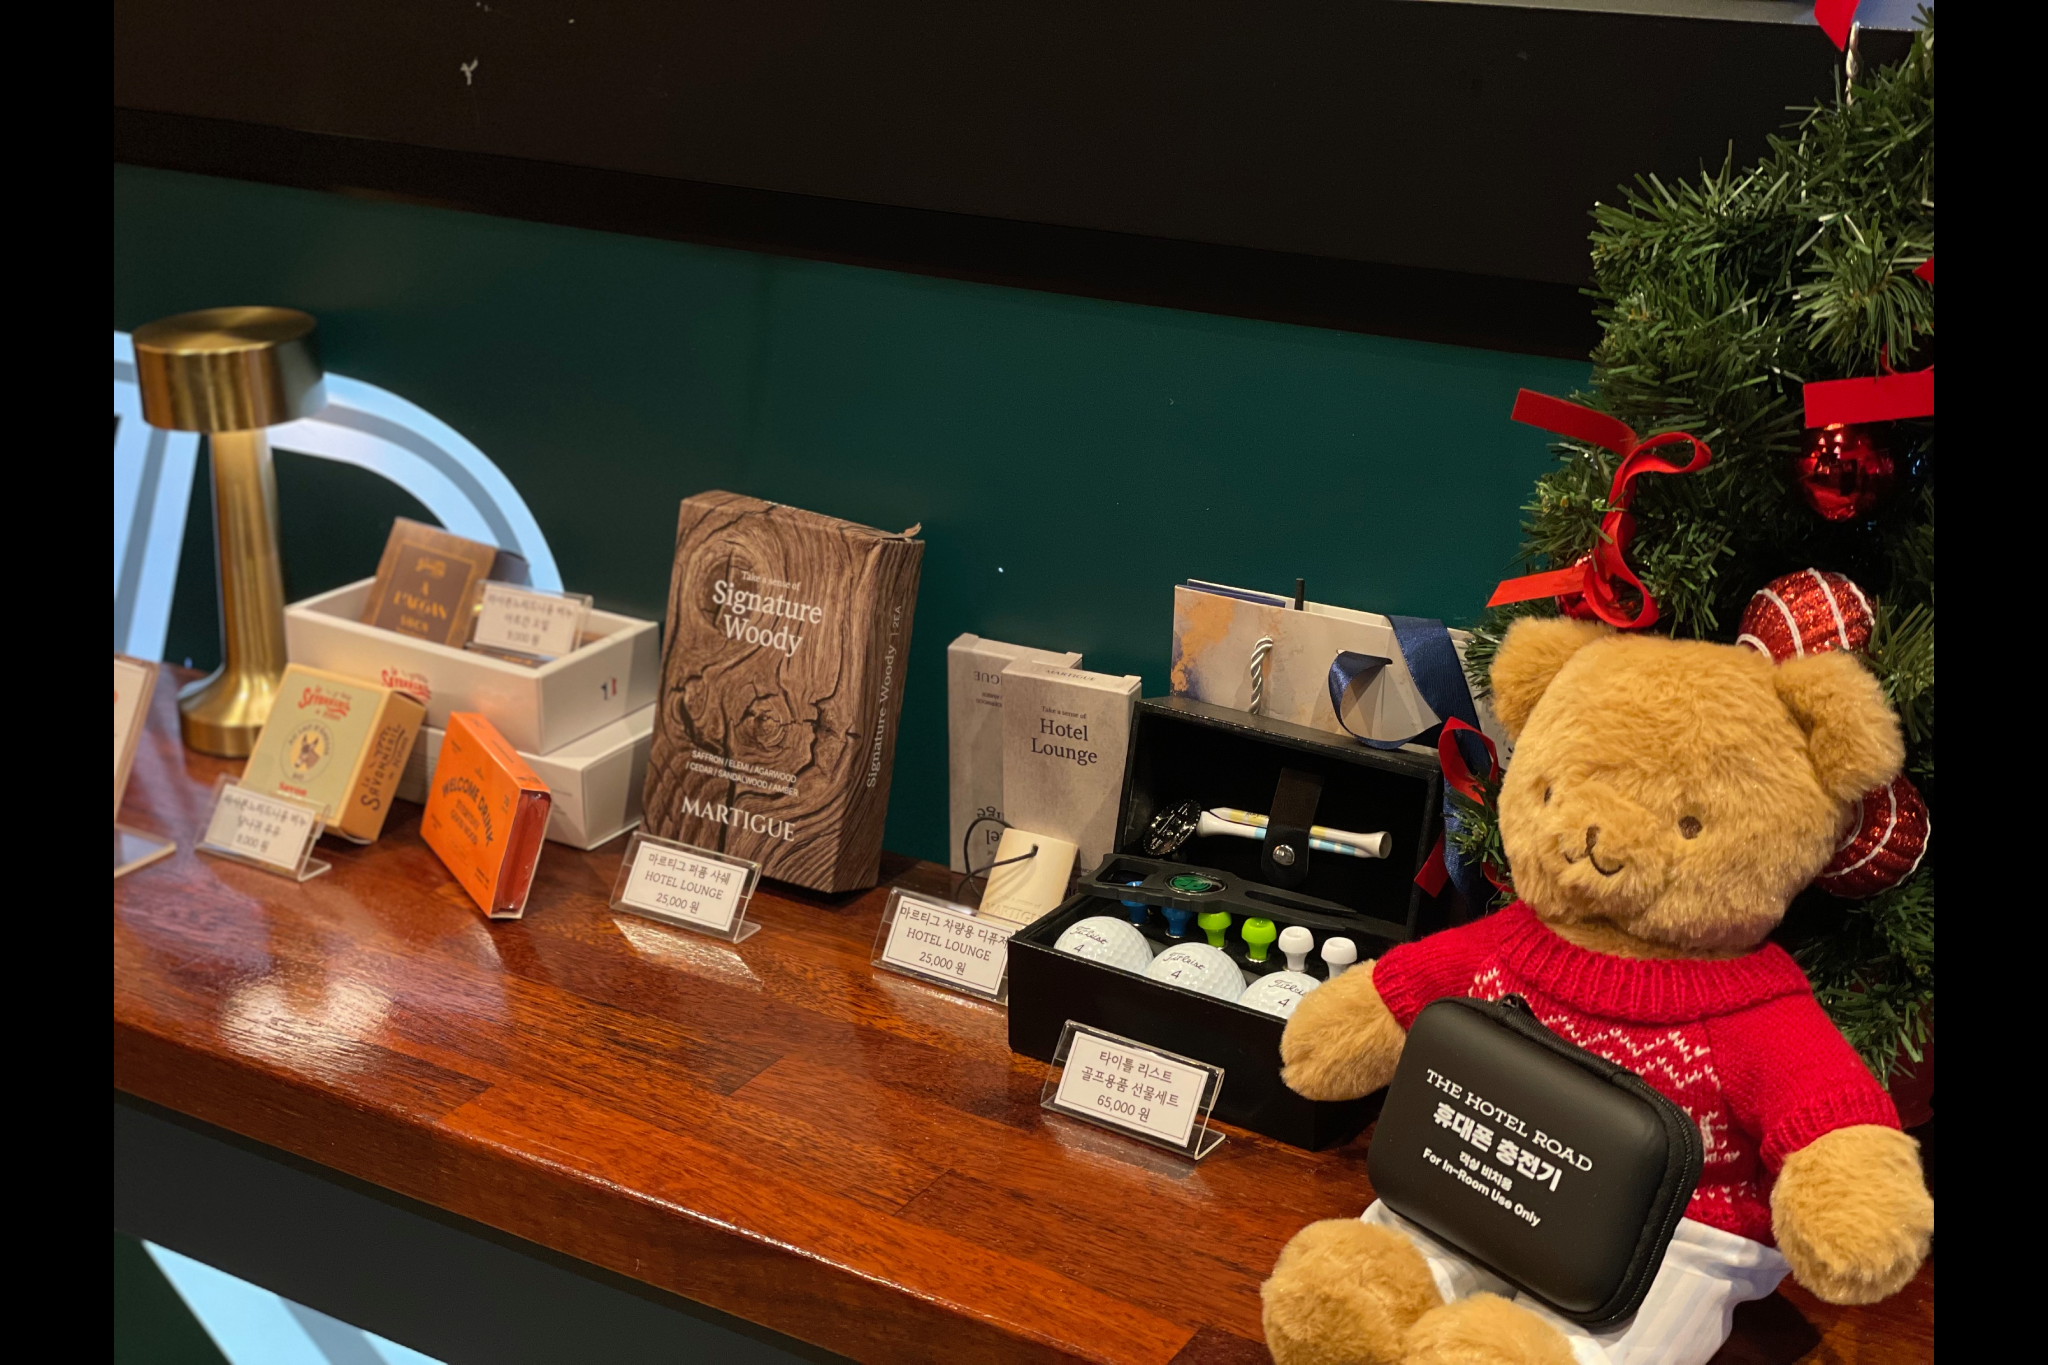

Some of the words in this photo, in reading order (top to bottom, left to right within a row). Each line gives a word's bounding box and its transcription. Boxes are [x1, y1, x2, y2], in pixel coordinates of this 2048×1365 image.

[741, 570, 760, 584] Take
[768, 579, 790, 589] sense
[791, 581, 801, 591] of
[712, 579, 822, 624] Signature
[724, 614, 803, 657] Woody
[867, 708, 886, 787] Signature
[880, 645, 897, 703] Woody
[892, 606, 902, 628] 2EA
[1041, 705, 1057, 714] Take
[1062, 710, 1080, 719] sense
[1039, 717, 1089, 741] Hotel
[692, 750, 724, 765] SAFFRON
[729, 760, 749, 773] ELEMI
[754, 766, 797, 783] AGARWOOD
[1031, 737, 1098, 767] Lounge
[690, 762, 713, 776] CEDAR
[718, 769, 768, 789] SANDALWOOD
[773, 785, 799, 797] AMBER
[442, 777, 480, 801] WELCOME
[477, 796, 494, 847] DRINK
[681, 796, 796, 841] MARTIGUE
[648, 853, 686, 872] 마르티그
[644, 870, 678, 889] HOTEL
[680, 879, 724, 900] LOUNGE
[656, 892, 688, 909] 25,000
[689, 901, 700, 914] 원
[900, 906, 941, 927] 마르티그
[943, 918, 975, 938] 차량용
[906, 927, 942, 947] HOTEL
[945, 938, 992, 961] LOUNGE
[1074, 943, 1085, 953] 4
[919, 951, 953, 970] 25,000
[955, 962, 966, 975] 원
[1170, 969, 1182, 980] 4
[1278, 997, 1290, 1008] 4
[1099, 1050, 1134, 1074] 타이틀
[1137, 1063, 1173, 1084] 리스트
[1081, 1065, 1129, 1093] 골프용품
[1131, 1082, 1179, 1107] 선물세트
[1097, 1094, 1136, 1116] 65,000
[1137, 1107, 1151, 1123] 원
[1426, 1068, 1463, 1099] THE
[1464, 1091, 1528, 1138] HOTEL
[1531, 1129, 1593, 1172] ROAD
[1433, 1101, 1495, 1153] 휴대폰
[1495, 1137, 1563, 1192] 충전기
[1422, 1147, 1442, 1166] For
[1442, 1159, 1490, 1196] In-Room
[1490, 1188, 1513, 1210] Use
[1513, 1203, 1541, 1228] Only
[1458, 1150, 1481, 1172] 객실
[1480, 1164, 1513, 1192] 비치용
